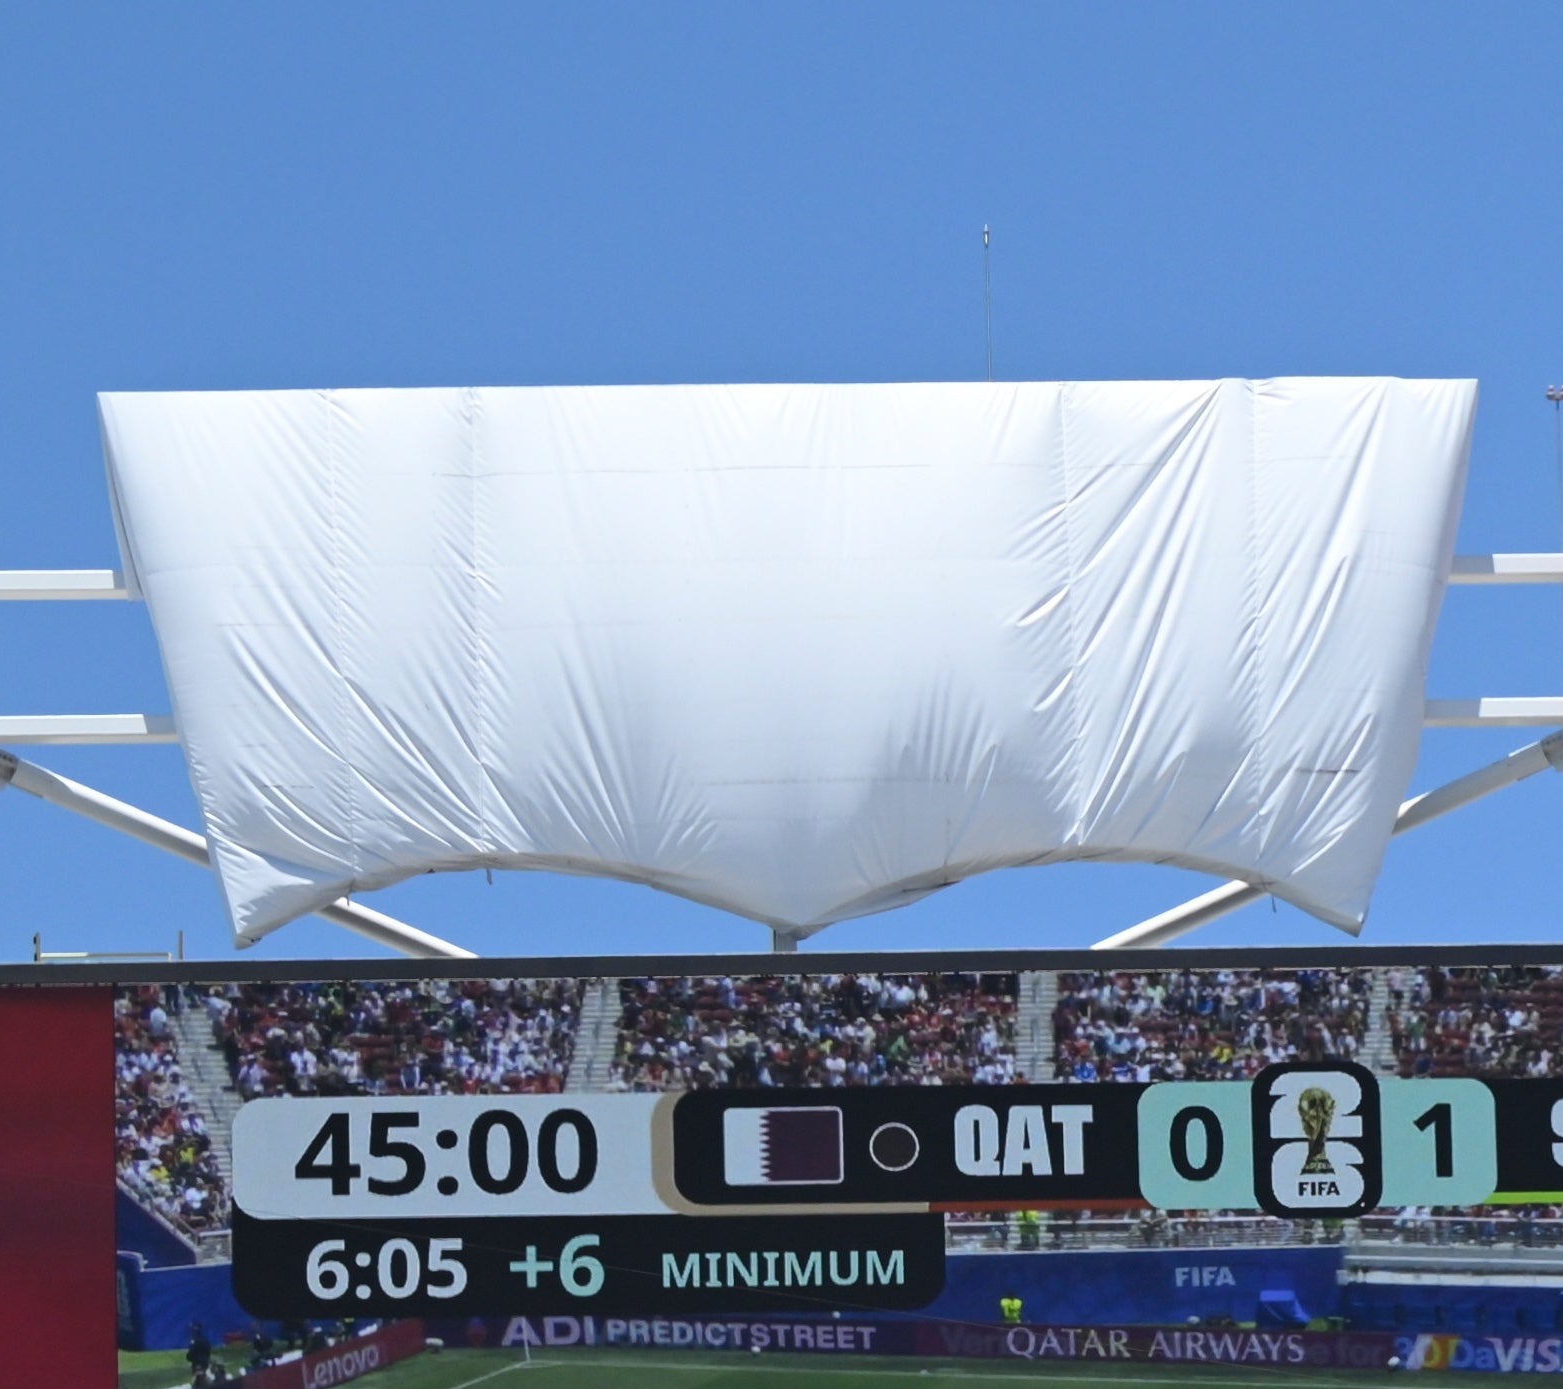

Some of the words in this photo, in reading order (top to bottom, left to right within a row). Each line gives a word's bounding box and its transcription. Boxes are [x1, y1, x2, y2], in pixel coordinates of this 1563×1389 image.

[294, 1108, 600, 1196] 45:00
[953, 1103, 1095, 1176] QAT
[1167, 1105, 1225, 1182] 0
[1411, 1102, 1454, 1178] 1
[1298, 1181, 1341, 1197] FIFA
[305, 1238, 469, 1301] 6:05
[509, 1234, 606, 1298] +6
[661, 1250, 906, 1289] MINIMUM
[1174, 1266, 1237, 1289] FIFA
[501, 1315, 595, 1347] ADI
[1006, 1327, 1131, 1361] QATAR
[1148, 1331, 1305, 1364] AIRWAYS
